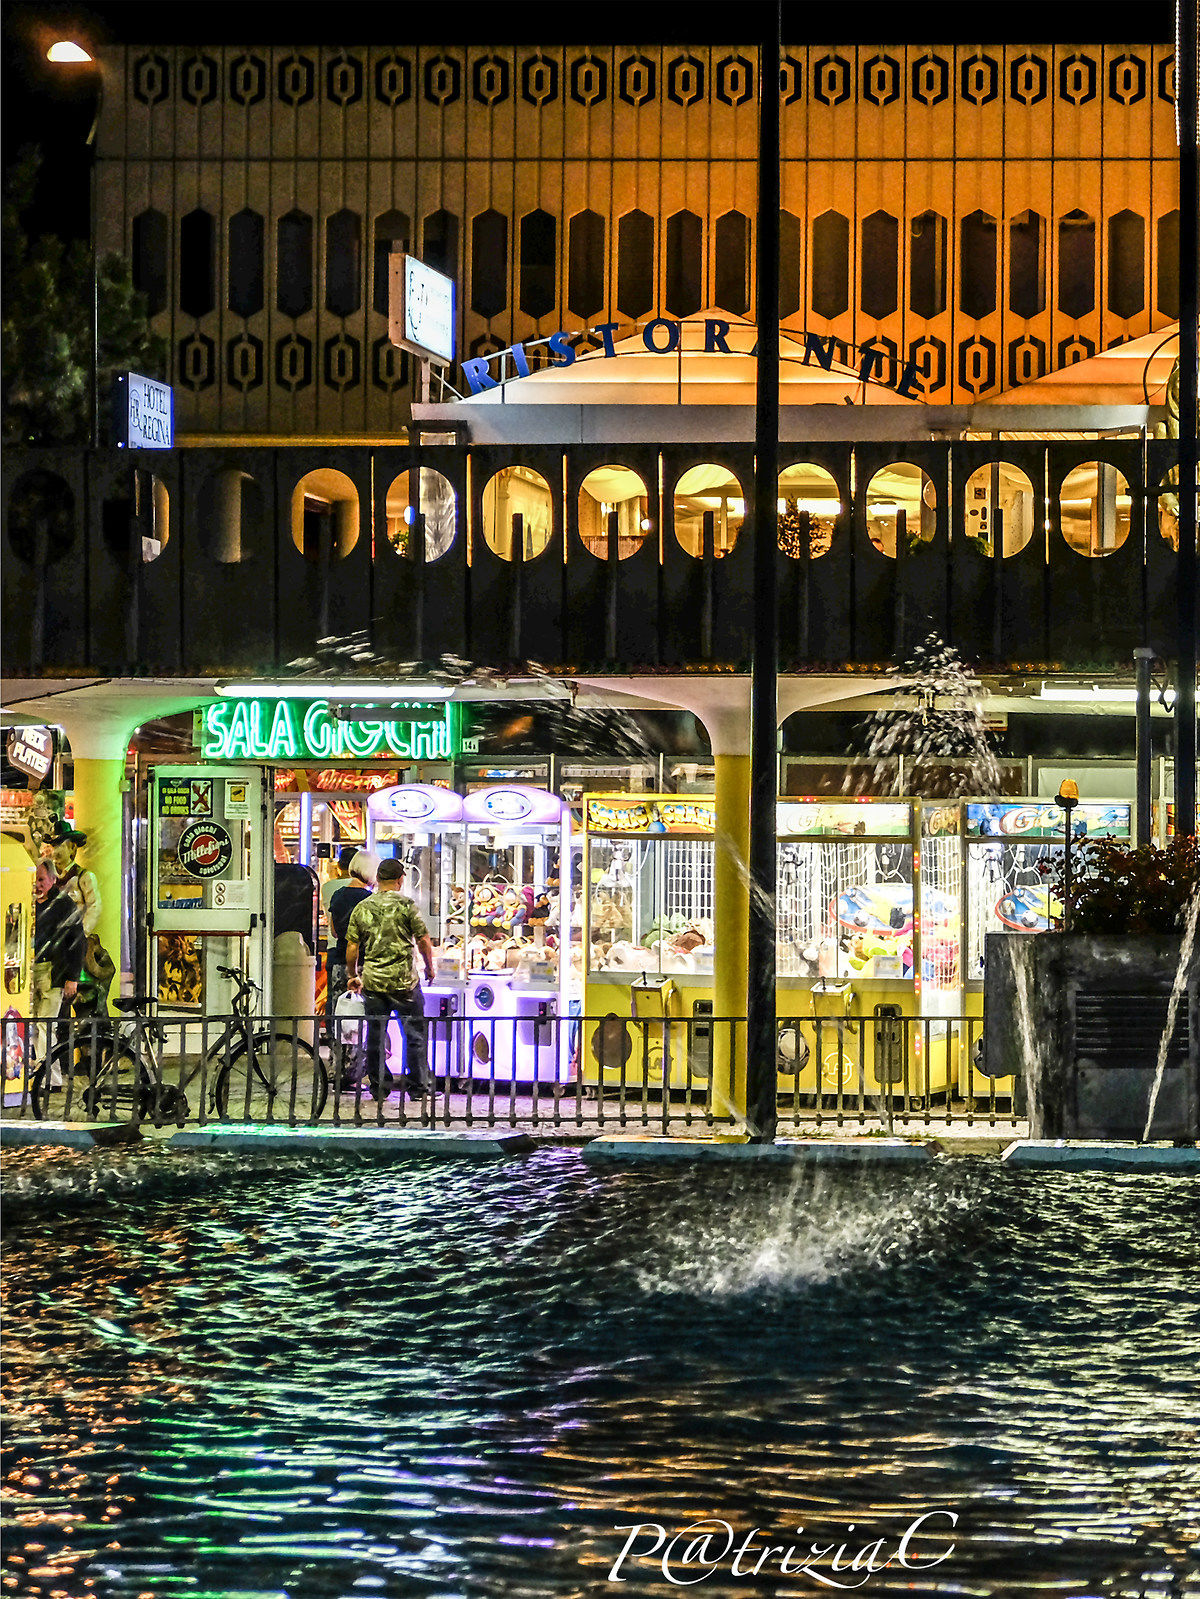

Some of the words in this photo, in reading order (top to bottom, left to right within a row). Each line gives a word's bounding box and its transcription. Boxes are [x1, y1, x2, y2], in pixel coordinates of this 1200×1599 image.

[461, 318, 924, 400] RISTORNTE
[143, 383, 168, 415] HOTEL
[205, 701, 295, 757] SALA
[304, 700, 451, 759] GIOCHI
[13, 742, 50, 774] PLATES
